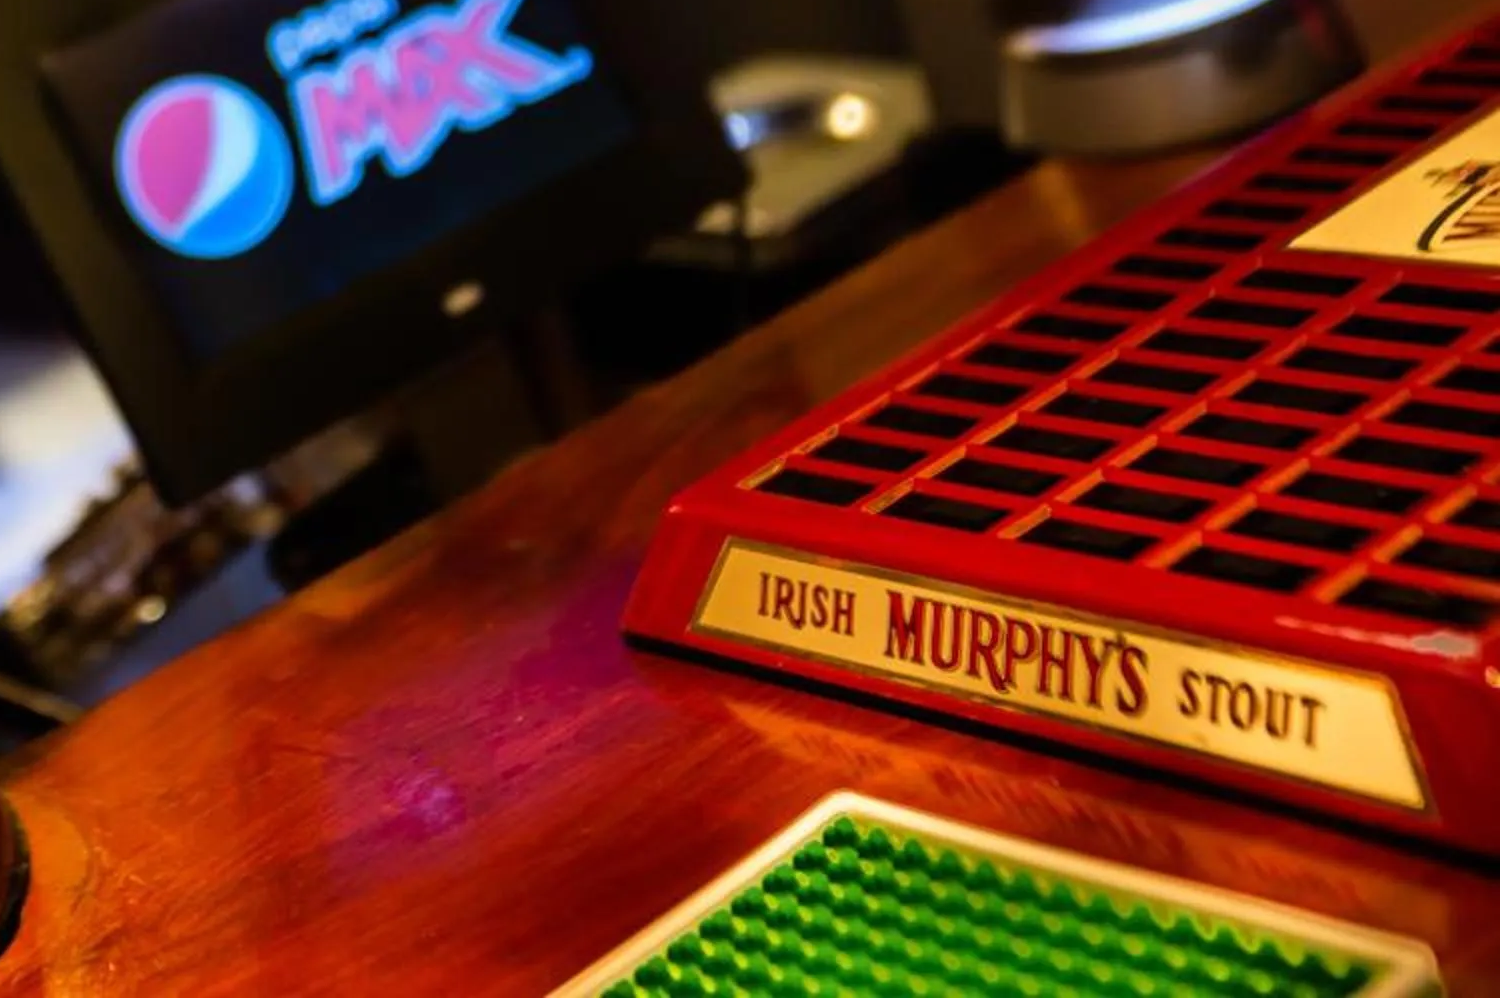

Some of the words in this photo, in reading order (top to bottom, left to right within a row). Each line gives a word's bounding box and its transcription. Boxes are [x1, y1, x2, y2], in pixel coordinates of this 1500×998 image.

[756, 571, 856, 637] IRISH
[883, 589, 1150, 717] MURPHY'S
[1177, 668, 1327, 749] STOUT
